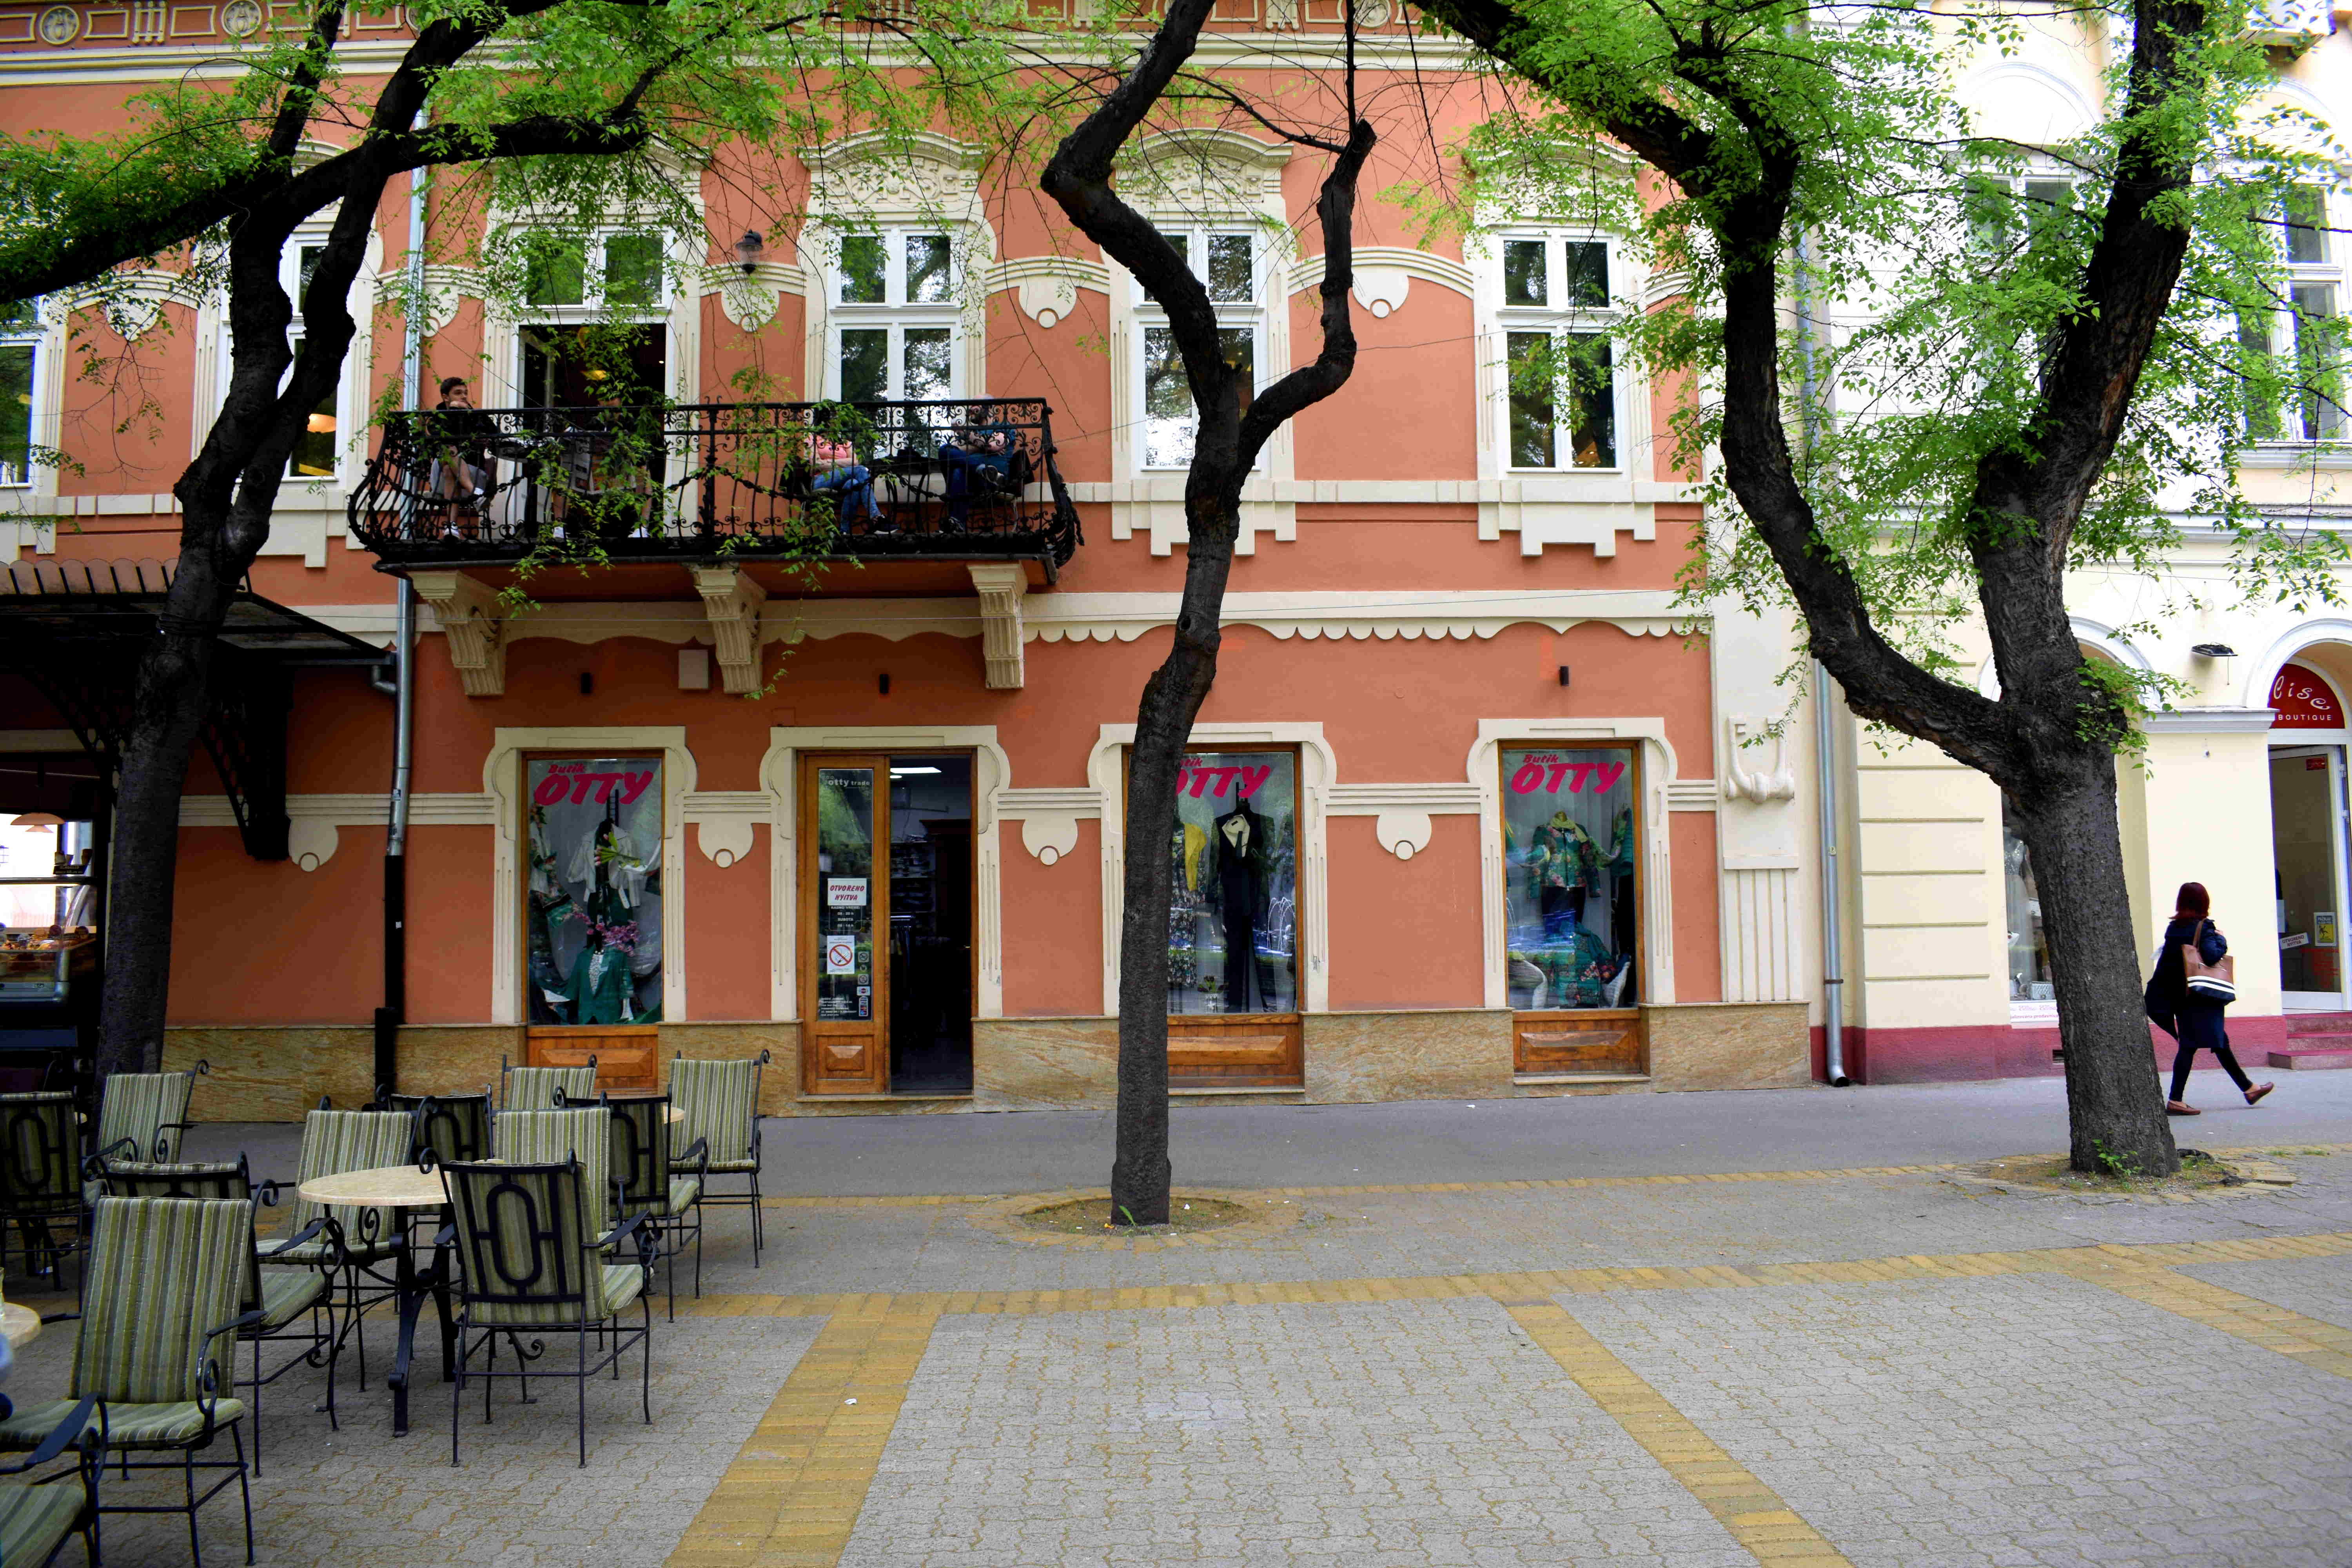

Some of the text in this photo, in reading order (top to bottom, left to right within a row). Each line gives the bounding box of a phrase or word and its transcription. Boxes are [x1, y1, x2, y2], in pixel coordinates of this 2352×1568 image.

[1180, 757, 1203, 766] tik
[1523, 754, 1559, 763] Butik
[548, 764, 585, 773] Butik
[1511, 761, 1625, 794] OTTY
[828, 779, 849, 787] otty
[534, 771, 653, 806] OTTY
[2282, 935, 2304, 944] OTVORENO
